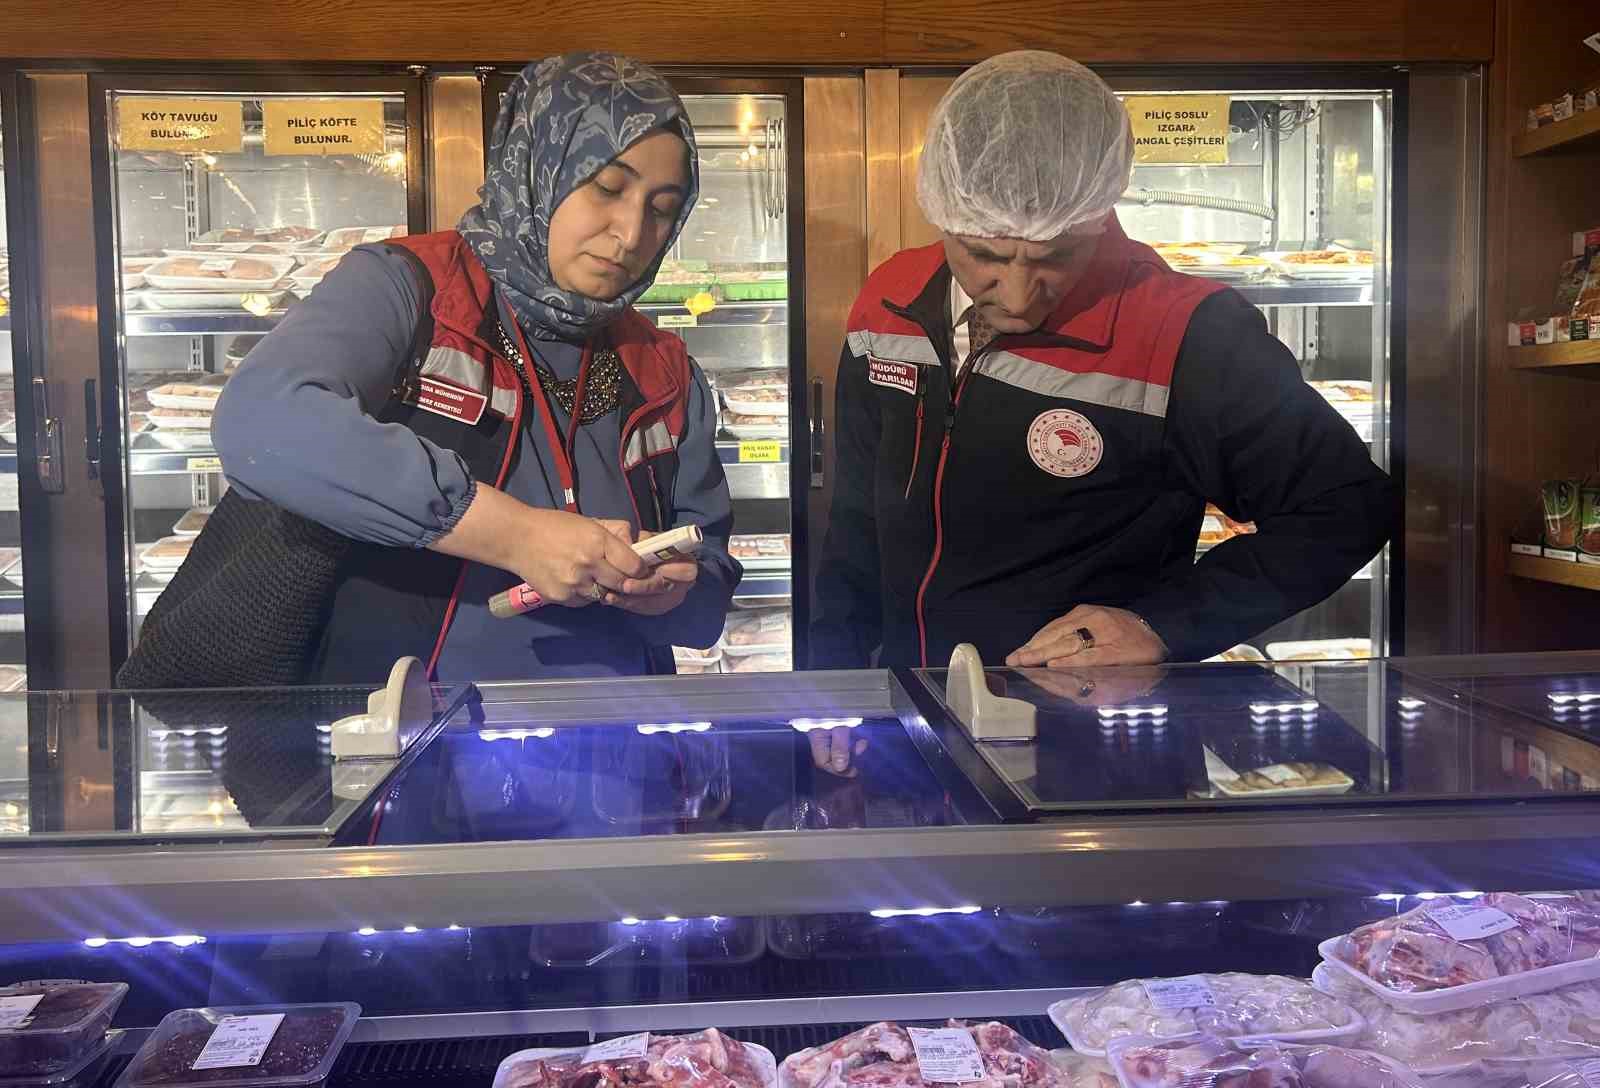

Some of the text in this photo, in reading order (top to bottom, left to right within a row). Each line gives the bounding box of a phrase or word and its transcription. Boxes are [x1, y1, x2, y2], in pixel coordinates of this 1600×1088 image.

[141, 112, 218, 122] KÖY TAVUĞU
[1145, 110, 1208, 120] PİLİÇ SOSLU
[287, 117, 357, 128] PİLİÇ KÖFTE
[1158, 124, 1196, 132] IZGARA
[294, 135, 353, 144] BULUNUR.
[1135, 136, 1225, 147] ANGAL ÇEŞİTLERİ
